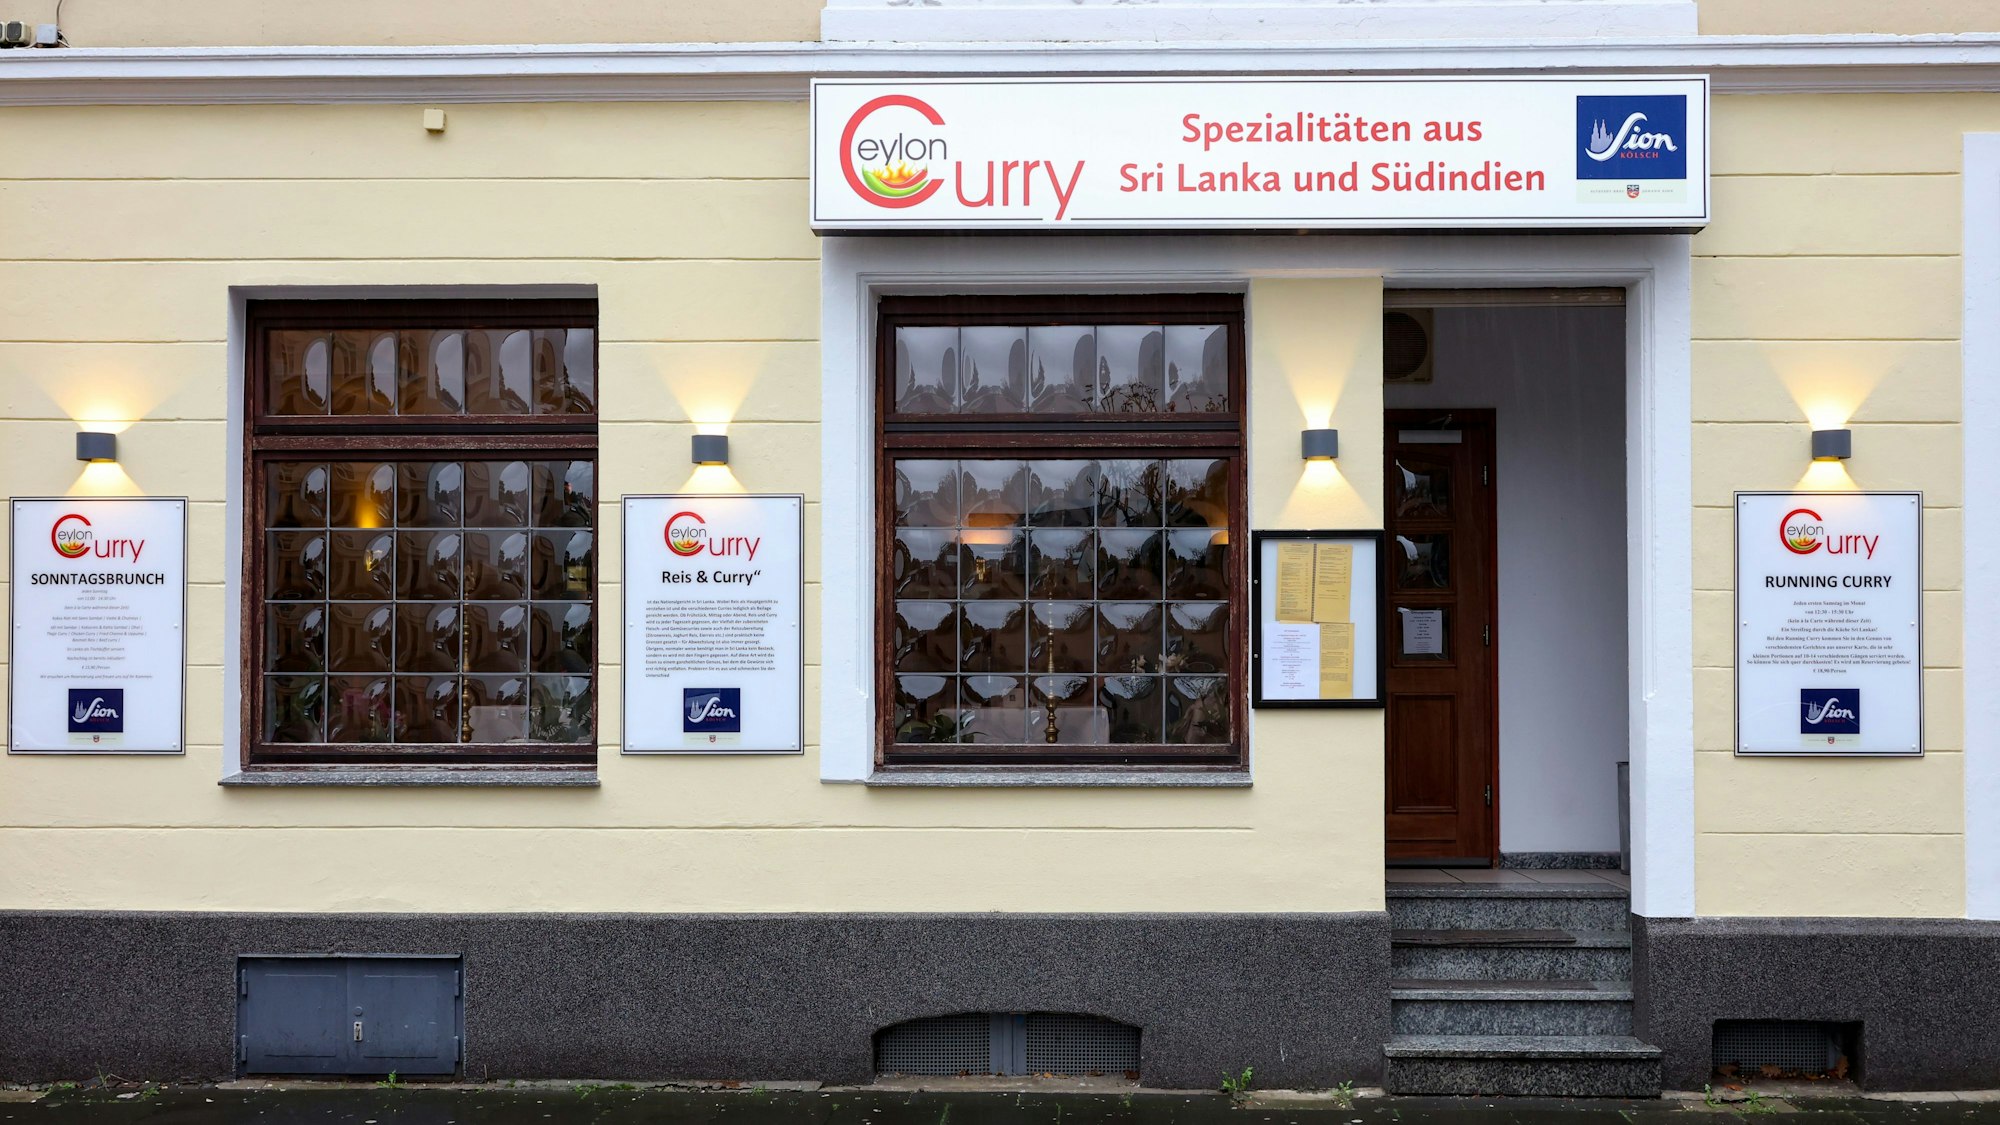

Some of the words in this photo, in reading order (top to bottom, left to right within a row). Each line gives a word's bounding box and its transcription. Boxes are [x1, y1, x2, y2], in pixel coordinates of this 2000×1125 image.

[1182, 112, 1411, 148] Spezialitäten
[1423, 119, 1483, 142] aus
[1585, 112, 1678, 162] Sion
[1620, 151, 1660, 159] KÖLSCH
[1119, 161, 1164, 190] Sri
[1178, 161, 1282, 190] Lanka
[1294, 161, 1359, 190] und
[1371, 160, 1545, 191] Südindien
[30, 573, 165, 586] SONNTAGSBRUNCH
[661, 570, 692, 584] Reis
[696, 570, 709, 584] &
[712, 570, 762, 587] Curry“
[1765, 576, 1838, 588] RUNNING
[1842, 576, 1892, 588] CURRY
